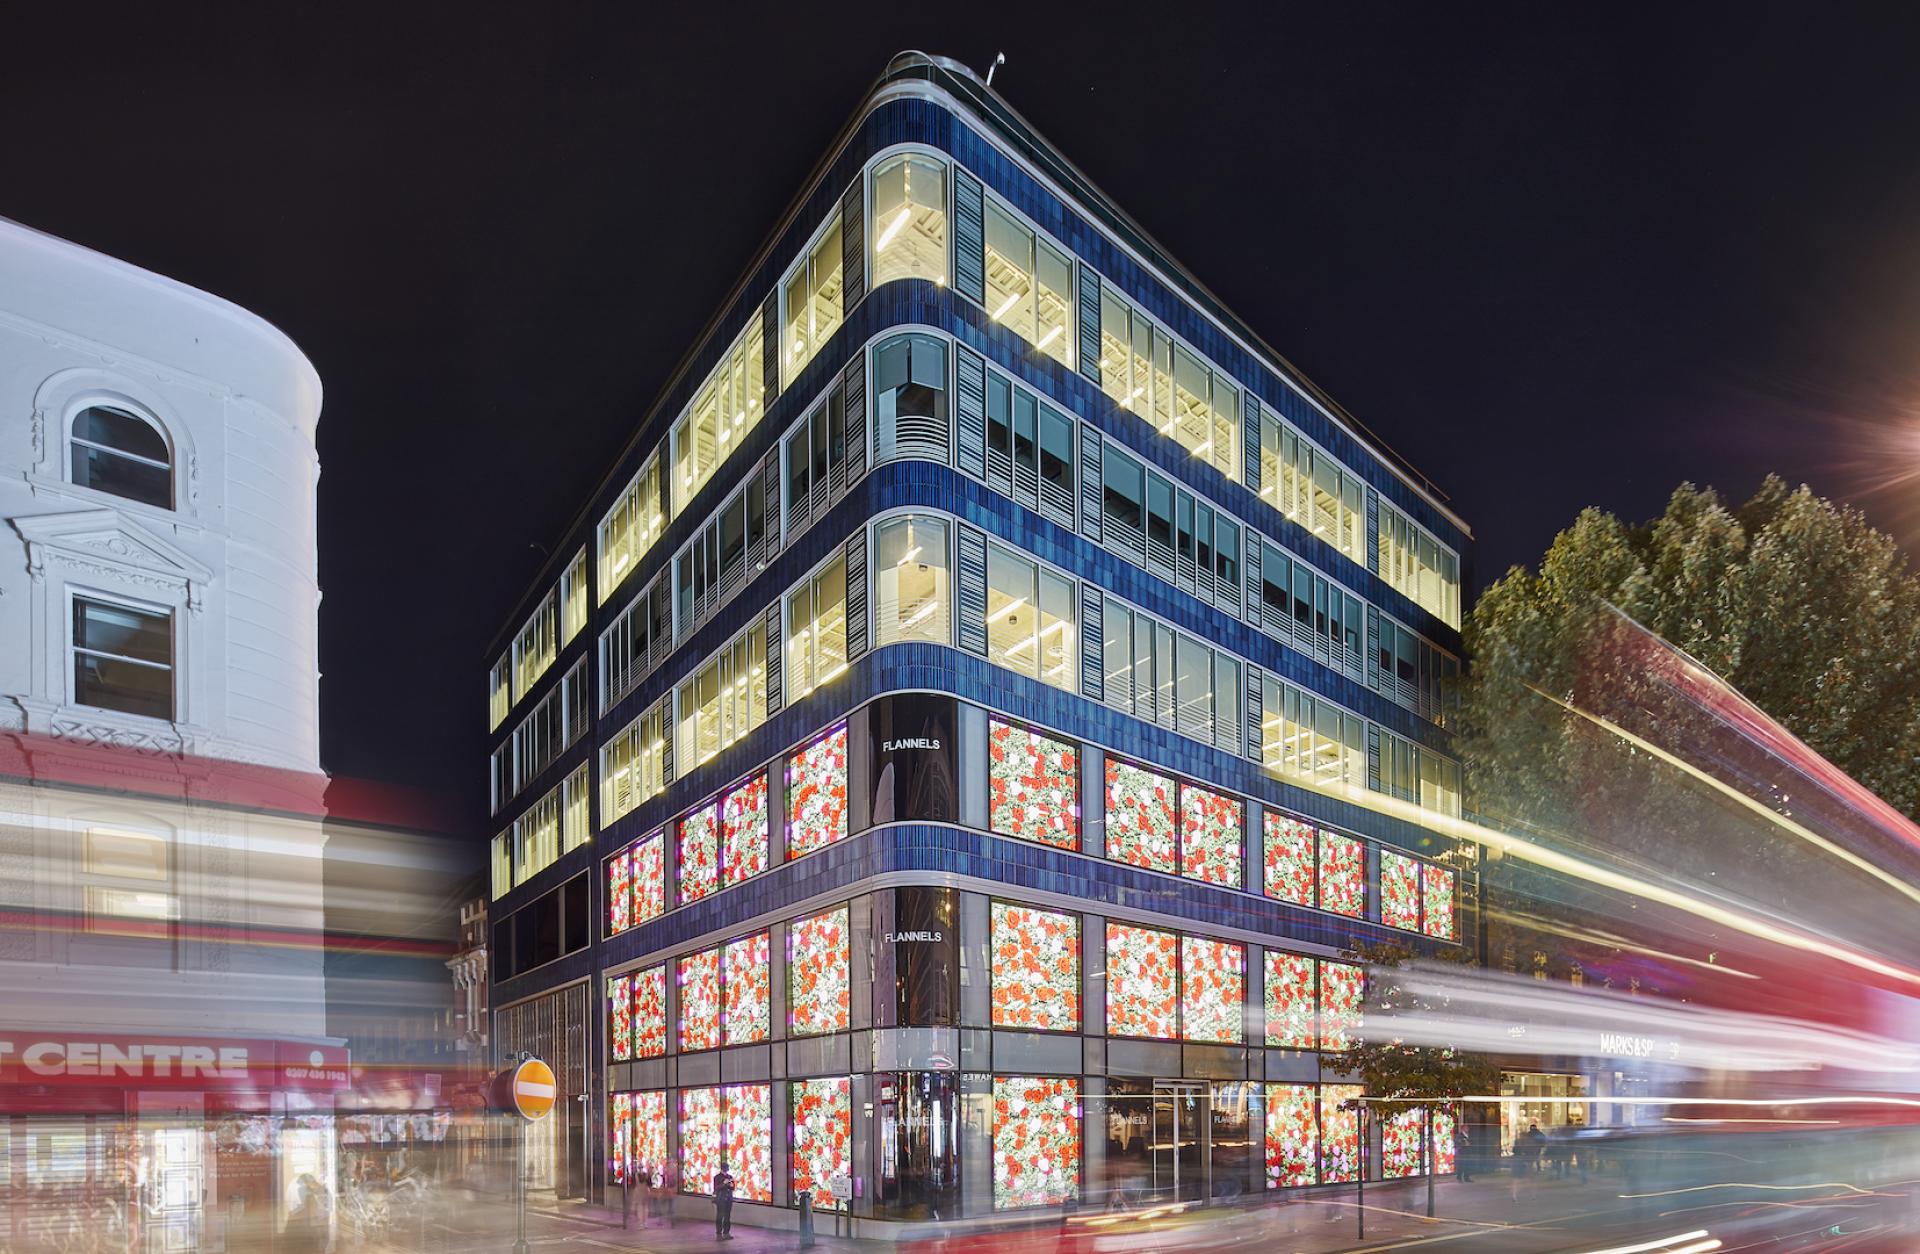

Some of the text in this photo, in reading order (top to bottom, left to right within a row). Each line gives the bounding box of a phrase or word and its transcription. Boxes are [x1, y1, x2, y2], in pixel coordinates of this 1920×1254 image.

[882, 738, 941, 752] FLANNELS
[885, 931, 942, 943] FLANNELS
[22, 1042, 248, 1078] CENTRE
